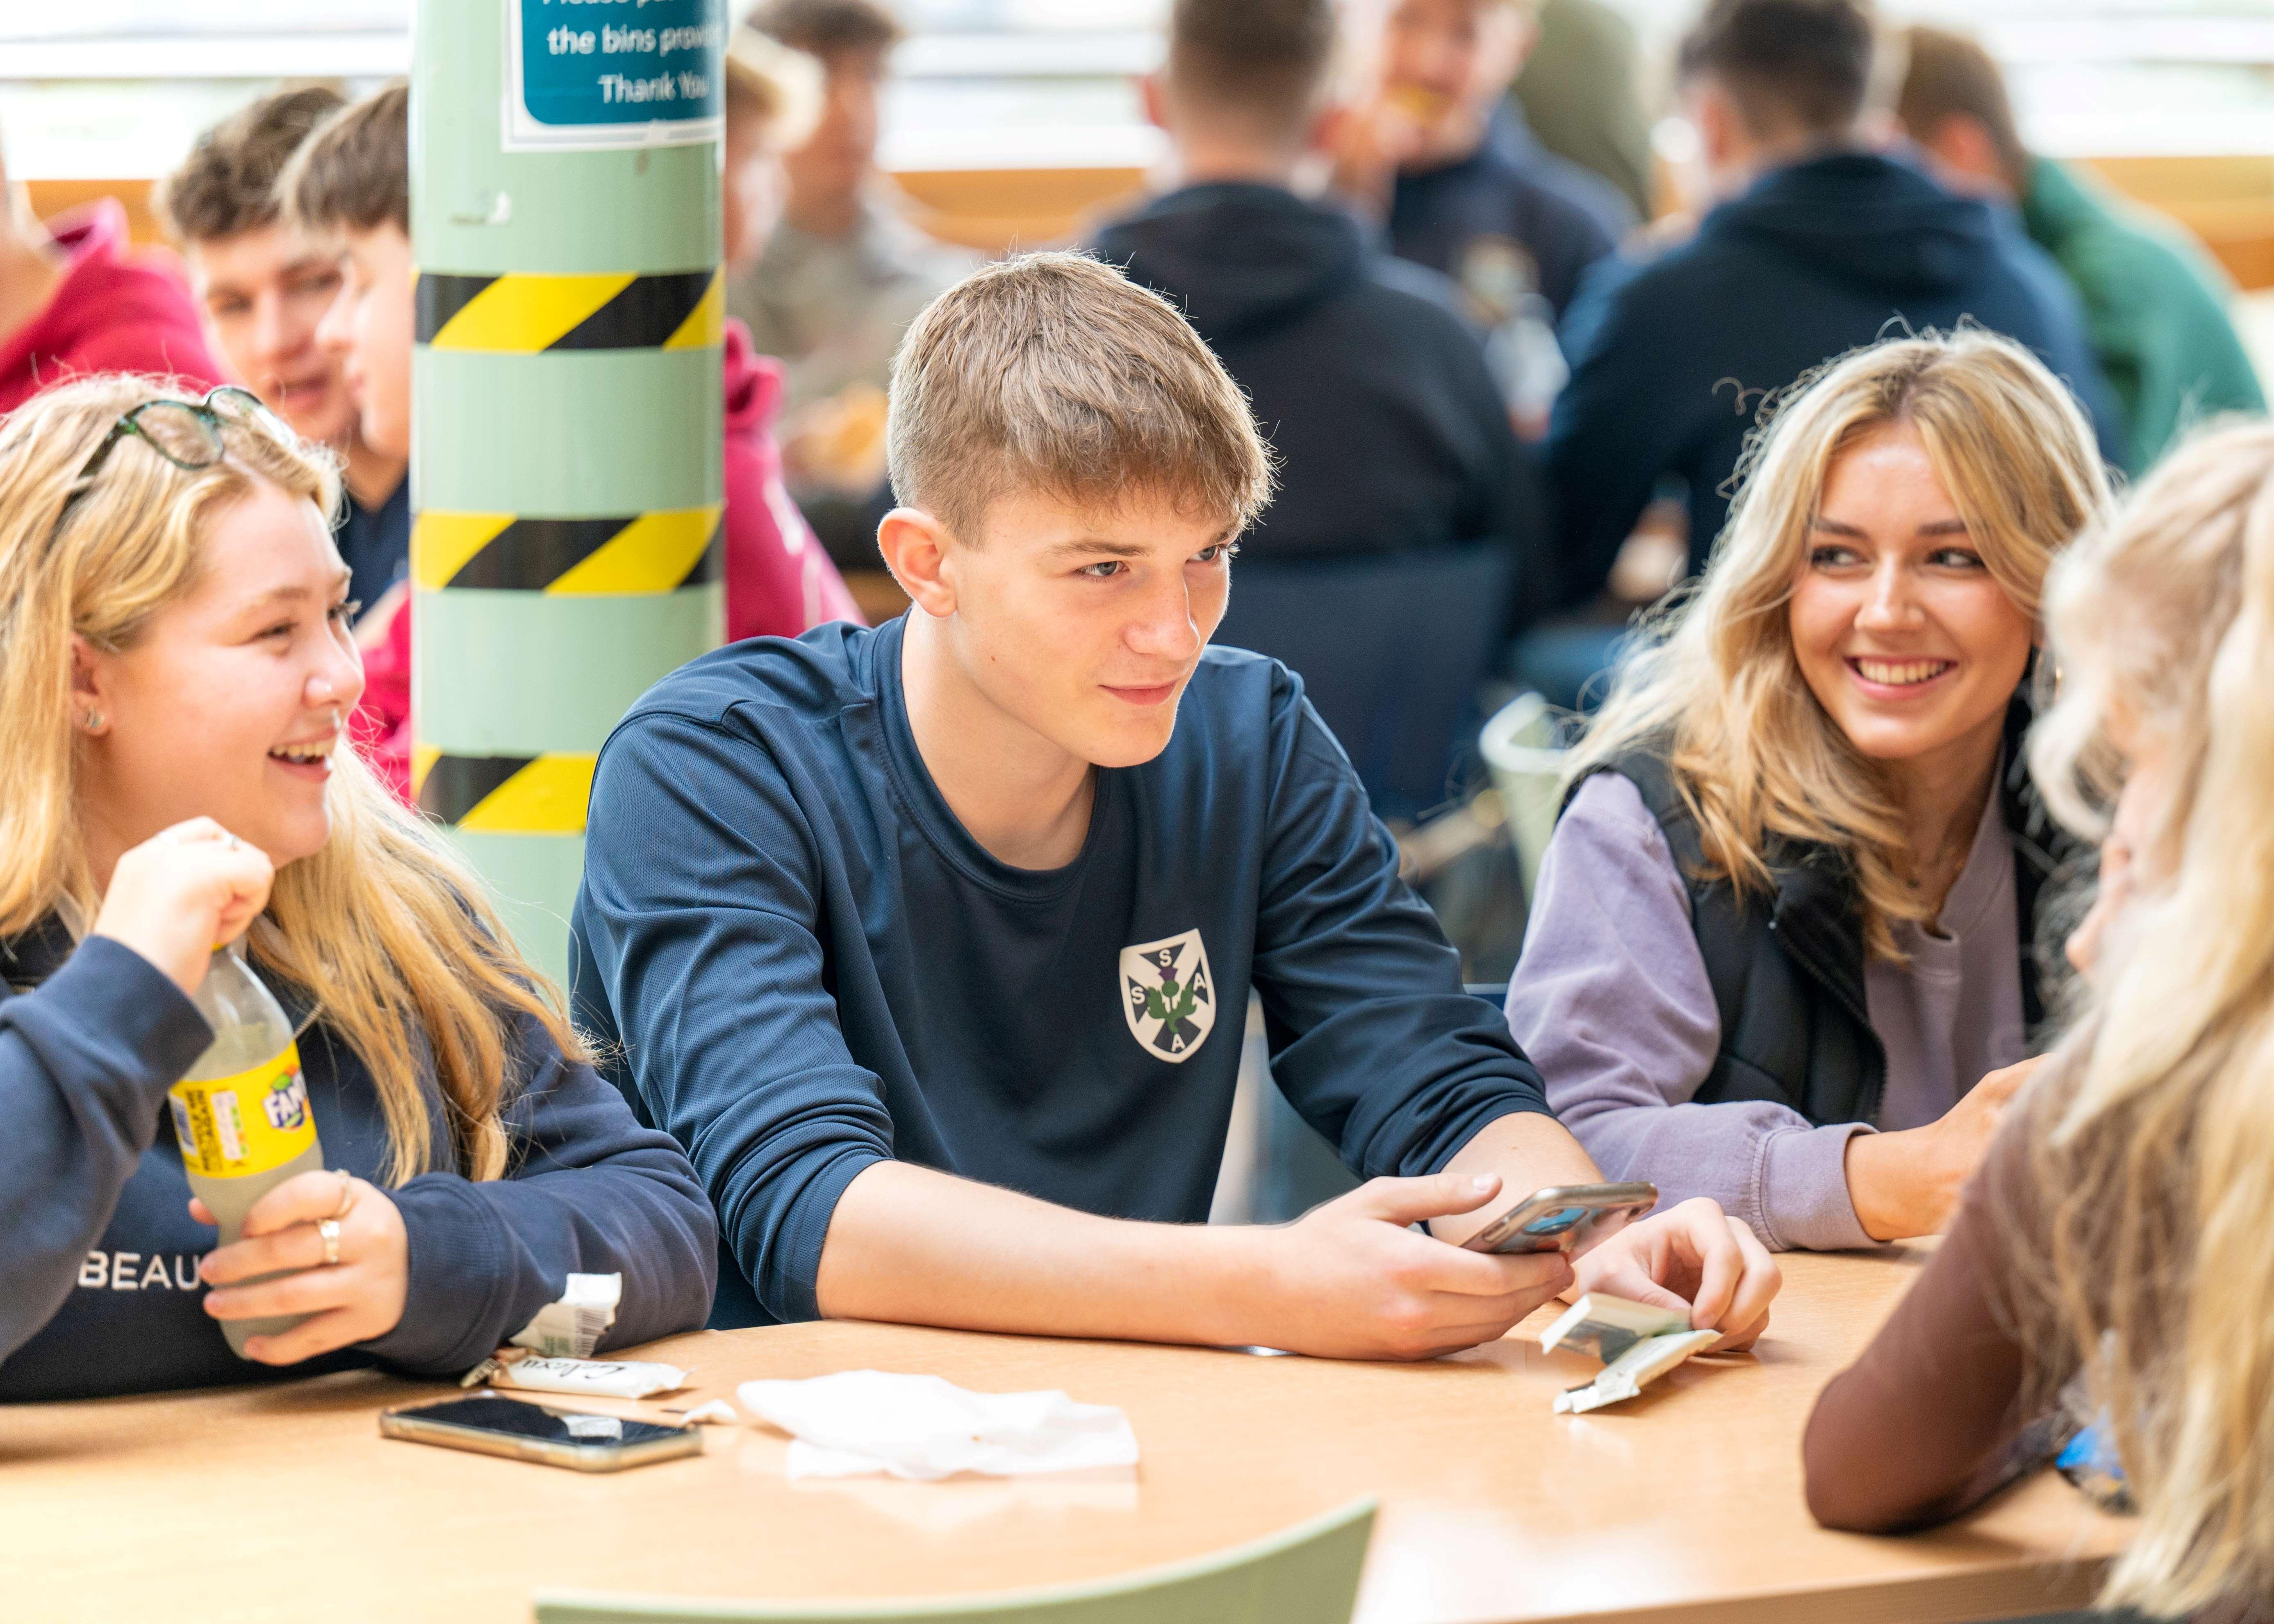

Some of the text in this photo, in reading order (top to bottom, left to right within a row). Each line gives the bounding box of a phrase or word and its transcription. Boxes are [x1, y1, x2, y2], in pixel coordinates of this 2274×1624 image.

[546, 24, 596, 55] the
[601, 23, 657, 54] bins
[597, 72, 677, 104] Thank
[1159, 948, 1172, 968] S
[1193, 972, 1206, 992] A
[1130, 985, 1146, 1005] S
[1171, 1033, 1186, 1053] A
